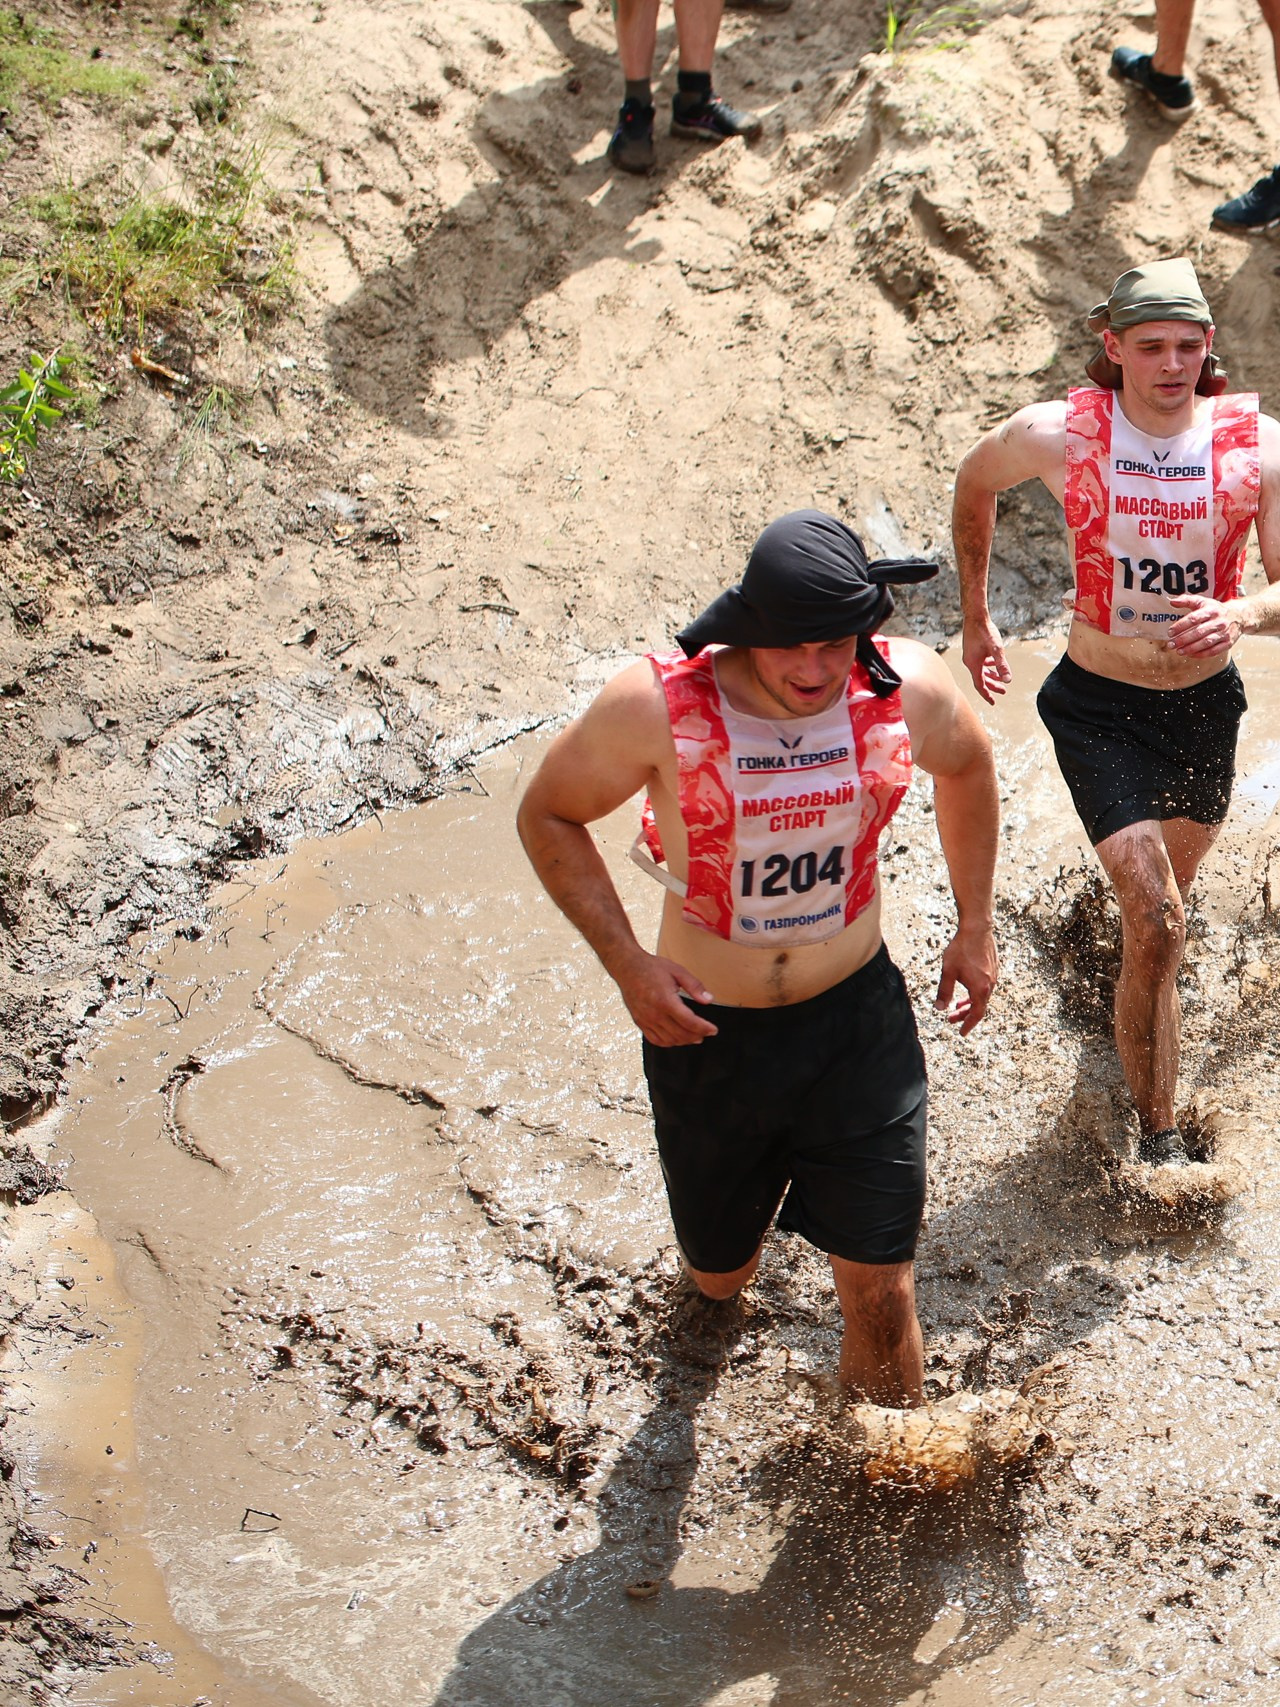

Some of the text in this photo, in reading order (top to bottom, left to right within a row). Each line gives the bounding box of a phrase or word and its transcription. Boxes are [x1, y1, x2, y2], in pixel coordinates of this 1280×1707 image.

[1116, 460, 1206, 477] ГОНКА ГЕРОЕВ
[1115, 496, 1207, 520] МАССОВЫЙ
[1138, 520, 1184, 541] СТАРТ
[1118, 557, 1209, 596] 1203
[1142, 613, 1185, 623] ГАЗПРОМ
[737, 747, 849, 770] ГОНКА ГЕРОЕВ
[742, 781, 854, 818] МАССОВЫЙ
[769, 810, 827, 833] СТАРТ
[740, 846, 845, 897] 1204
